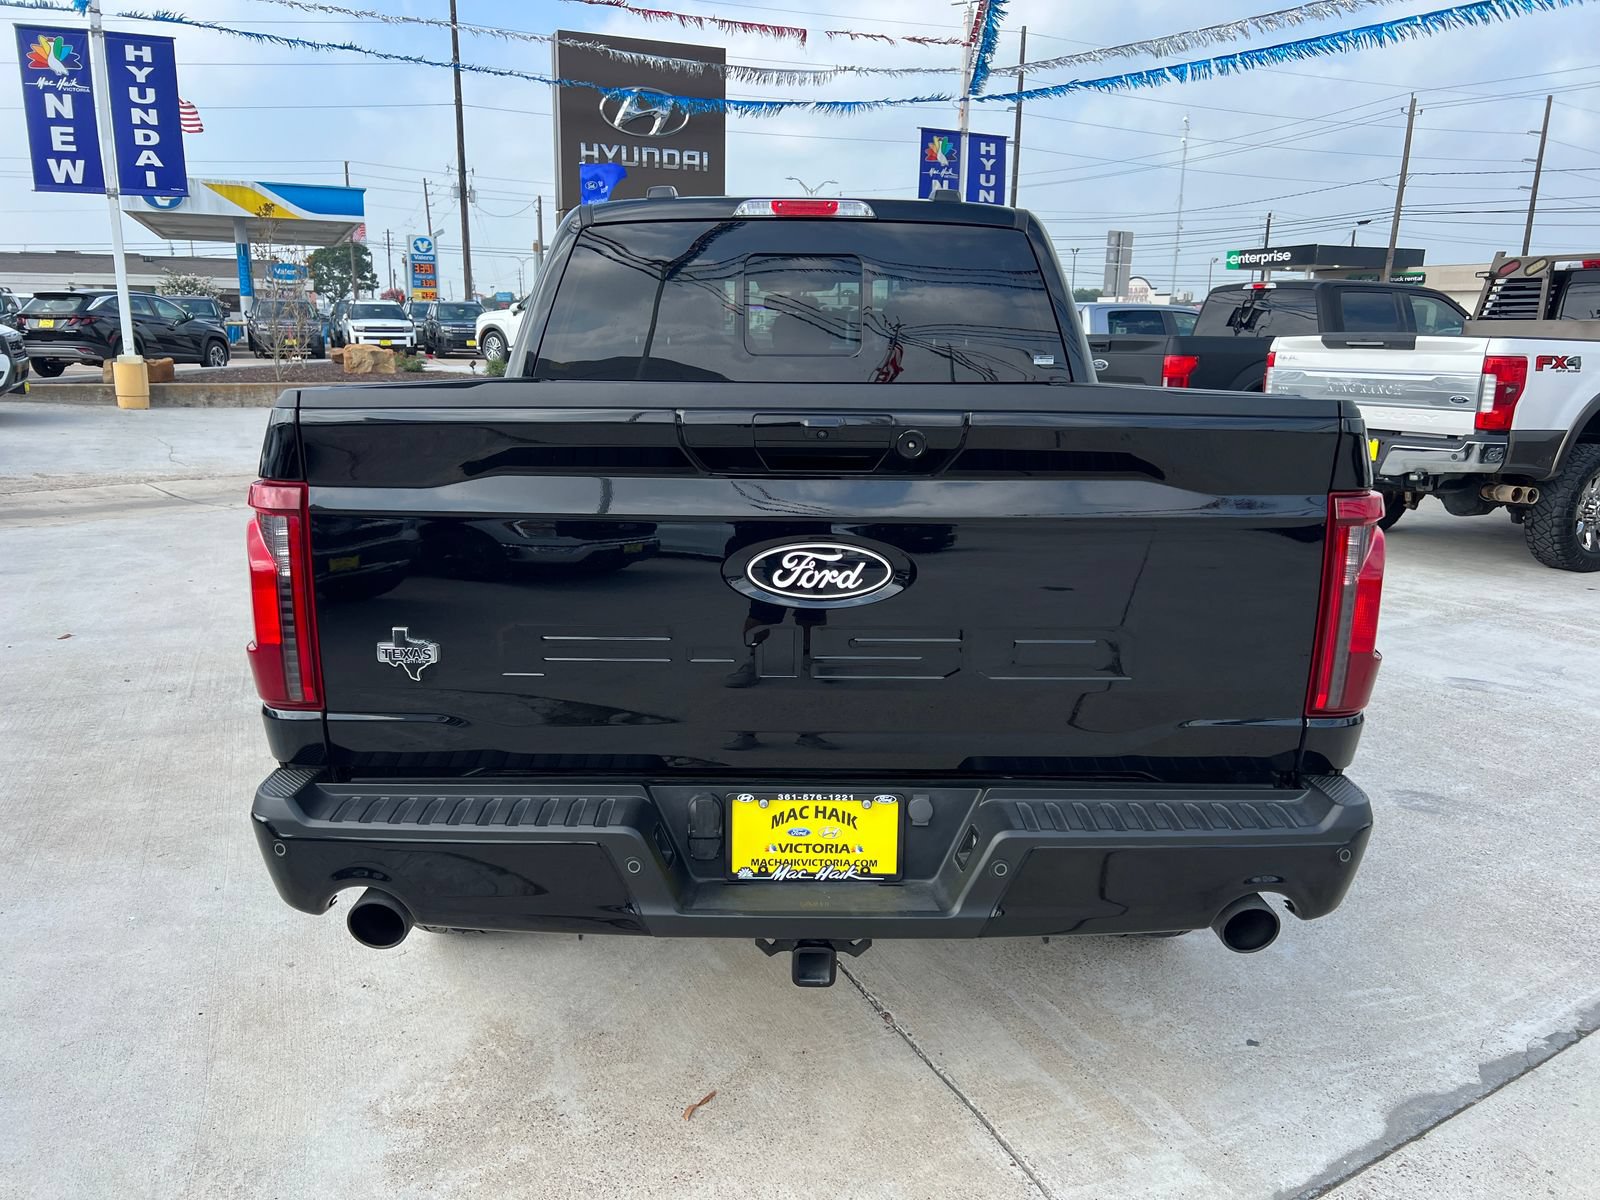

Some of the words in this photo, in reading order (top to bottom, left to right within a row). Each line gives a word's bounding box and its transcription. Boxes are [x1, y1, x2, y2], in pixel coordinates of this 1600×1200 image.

[124, 44, 164, 188] HYUNDAI
[44, 93, 85, 184] NEW
[580, 142, 709, 172] HYUNDAI
[1227, 250, 1292, 266] enterprise
[274, 268, 302, 276] Valer
[1535, 355, 1582, 372] FX4
[772, 551, 866, 589] Ford
[381, 648, 432, 660] TEXAS
[777, 793, 855, 801] 361-576-1221
[771, 806, 810, 829] MAC
[814, 805, 858, 830] HAIK
[789, 829, 808, 838] Ford
[778, 843, 851, 854] VICTORIA
[754, 864, 814, 881] Mac
[814, 864, 885, 881] Haik
